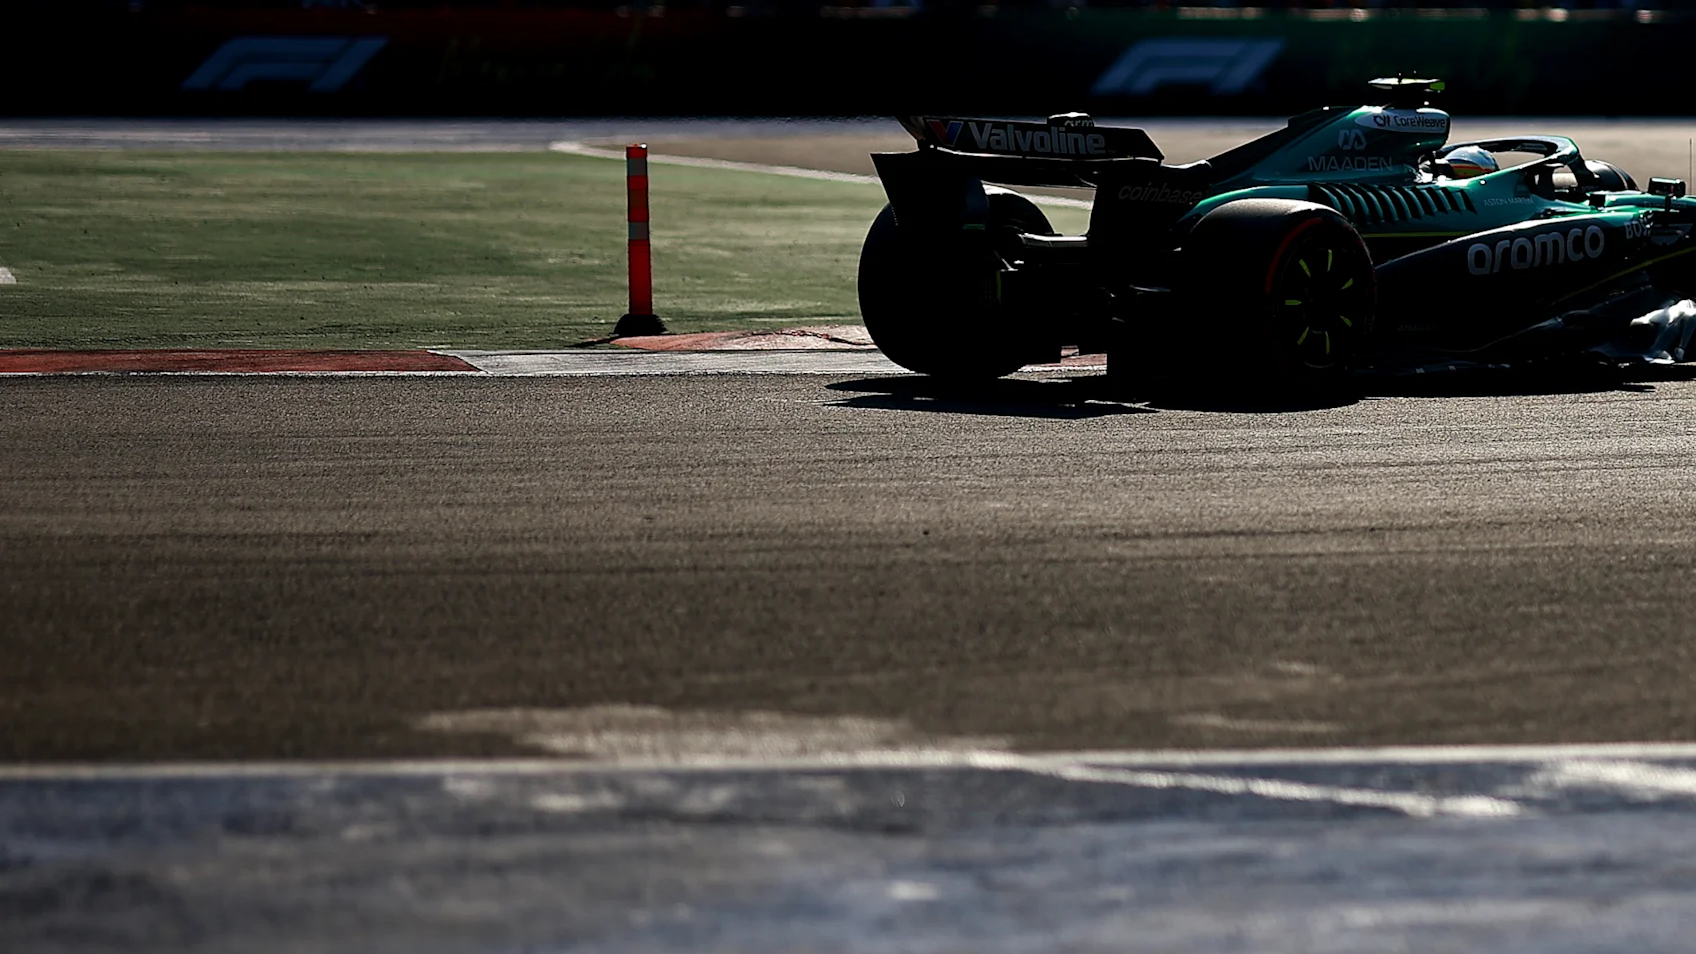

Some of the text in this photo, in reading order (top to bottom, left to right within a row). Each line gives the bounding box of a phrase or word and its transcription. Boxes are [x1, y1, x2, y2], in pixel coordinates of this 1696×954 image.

[1394, 115, 1446, 128] CoreWeave
[968, 121, 1106, 155] Valvoline
[1308, 155, 1393, 172] MAADEN
[1118, 182, 1202, 206] coinbase
[1467, 224, 1605, 276] aramco
